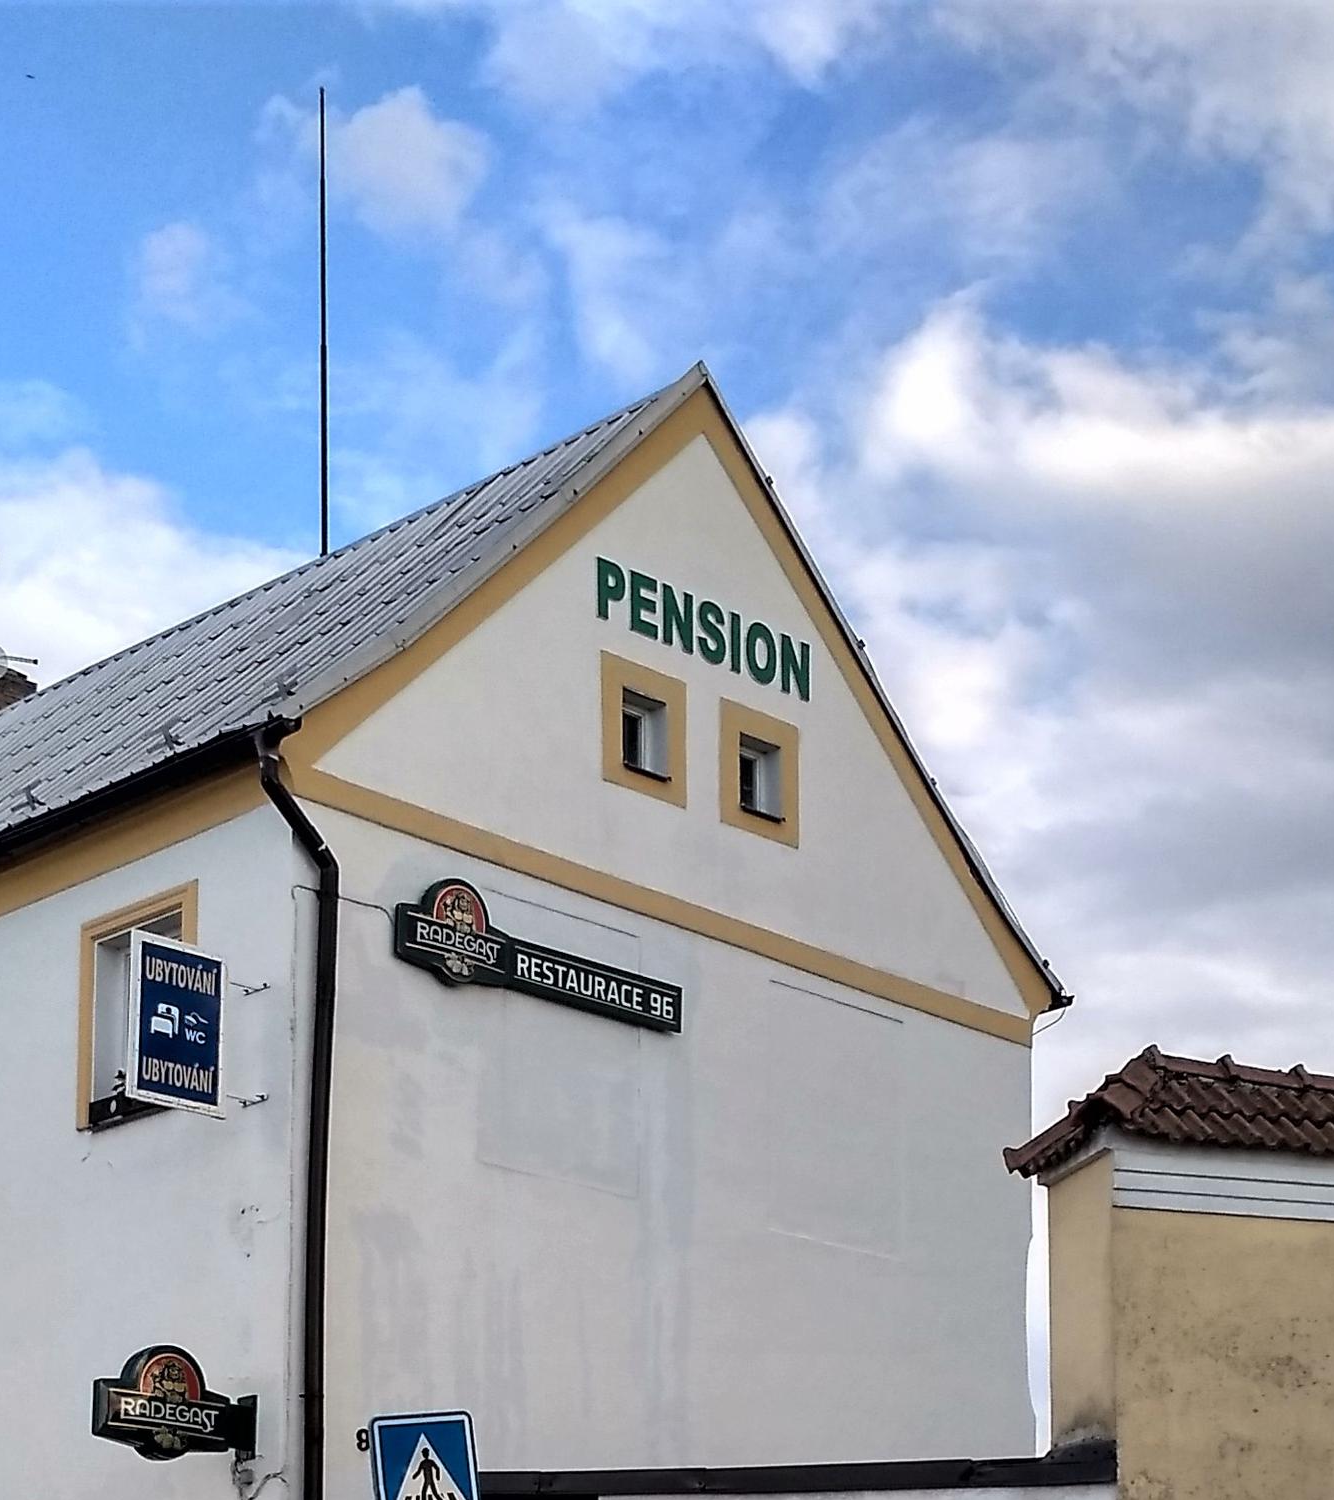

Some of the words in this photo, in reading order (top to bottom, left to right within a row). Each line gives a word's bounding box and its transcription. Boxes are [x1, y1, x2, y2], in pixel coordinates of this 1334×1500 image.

[596, 555, 811, 702] PENSION
[417, 920, 501, 964] RADEGAST
[145, 956, 217, 996] UBYTOVÁNÍ
[517, 953, 643, 1012] RESTAURACE
[650, 992, 674, 1021] 96
[184, 1028, 206, 1045] WC
[142, 1056, 215, 1094] UBYTOVÁNÍ
[120, 1398, 219, 1432] RADEGAST
